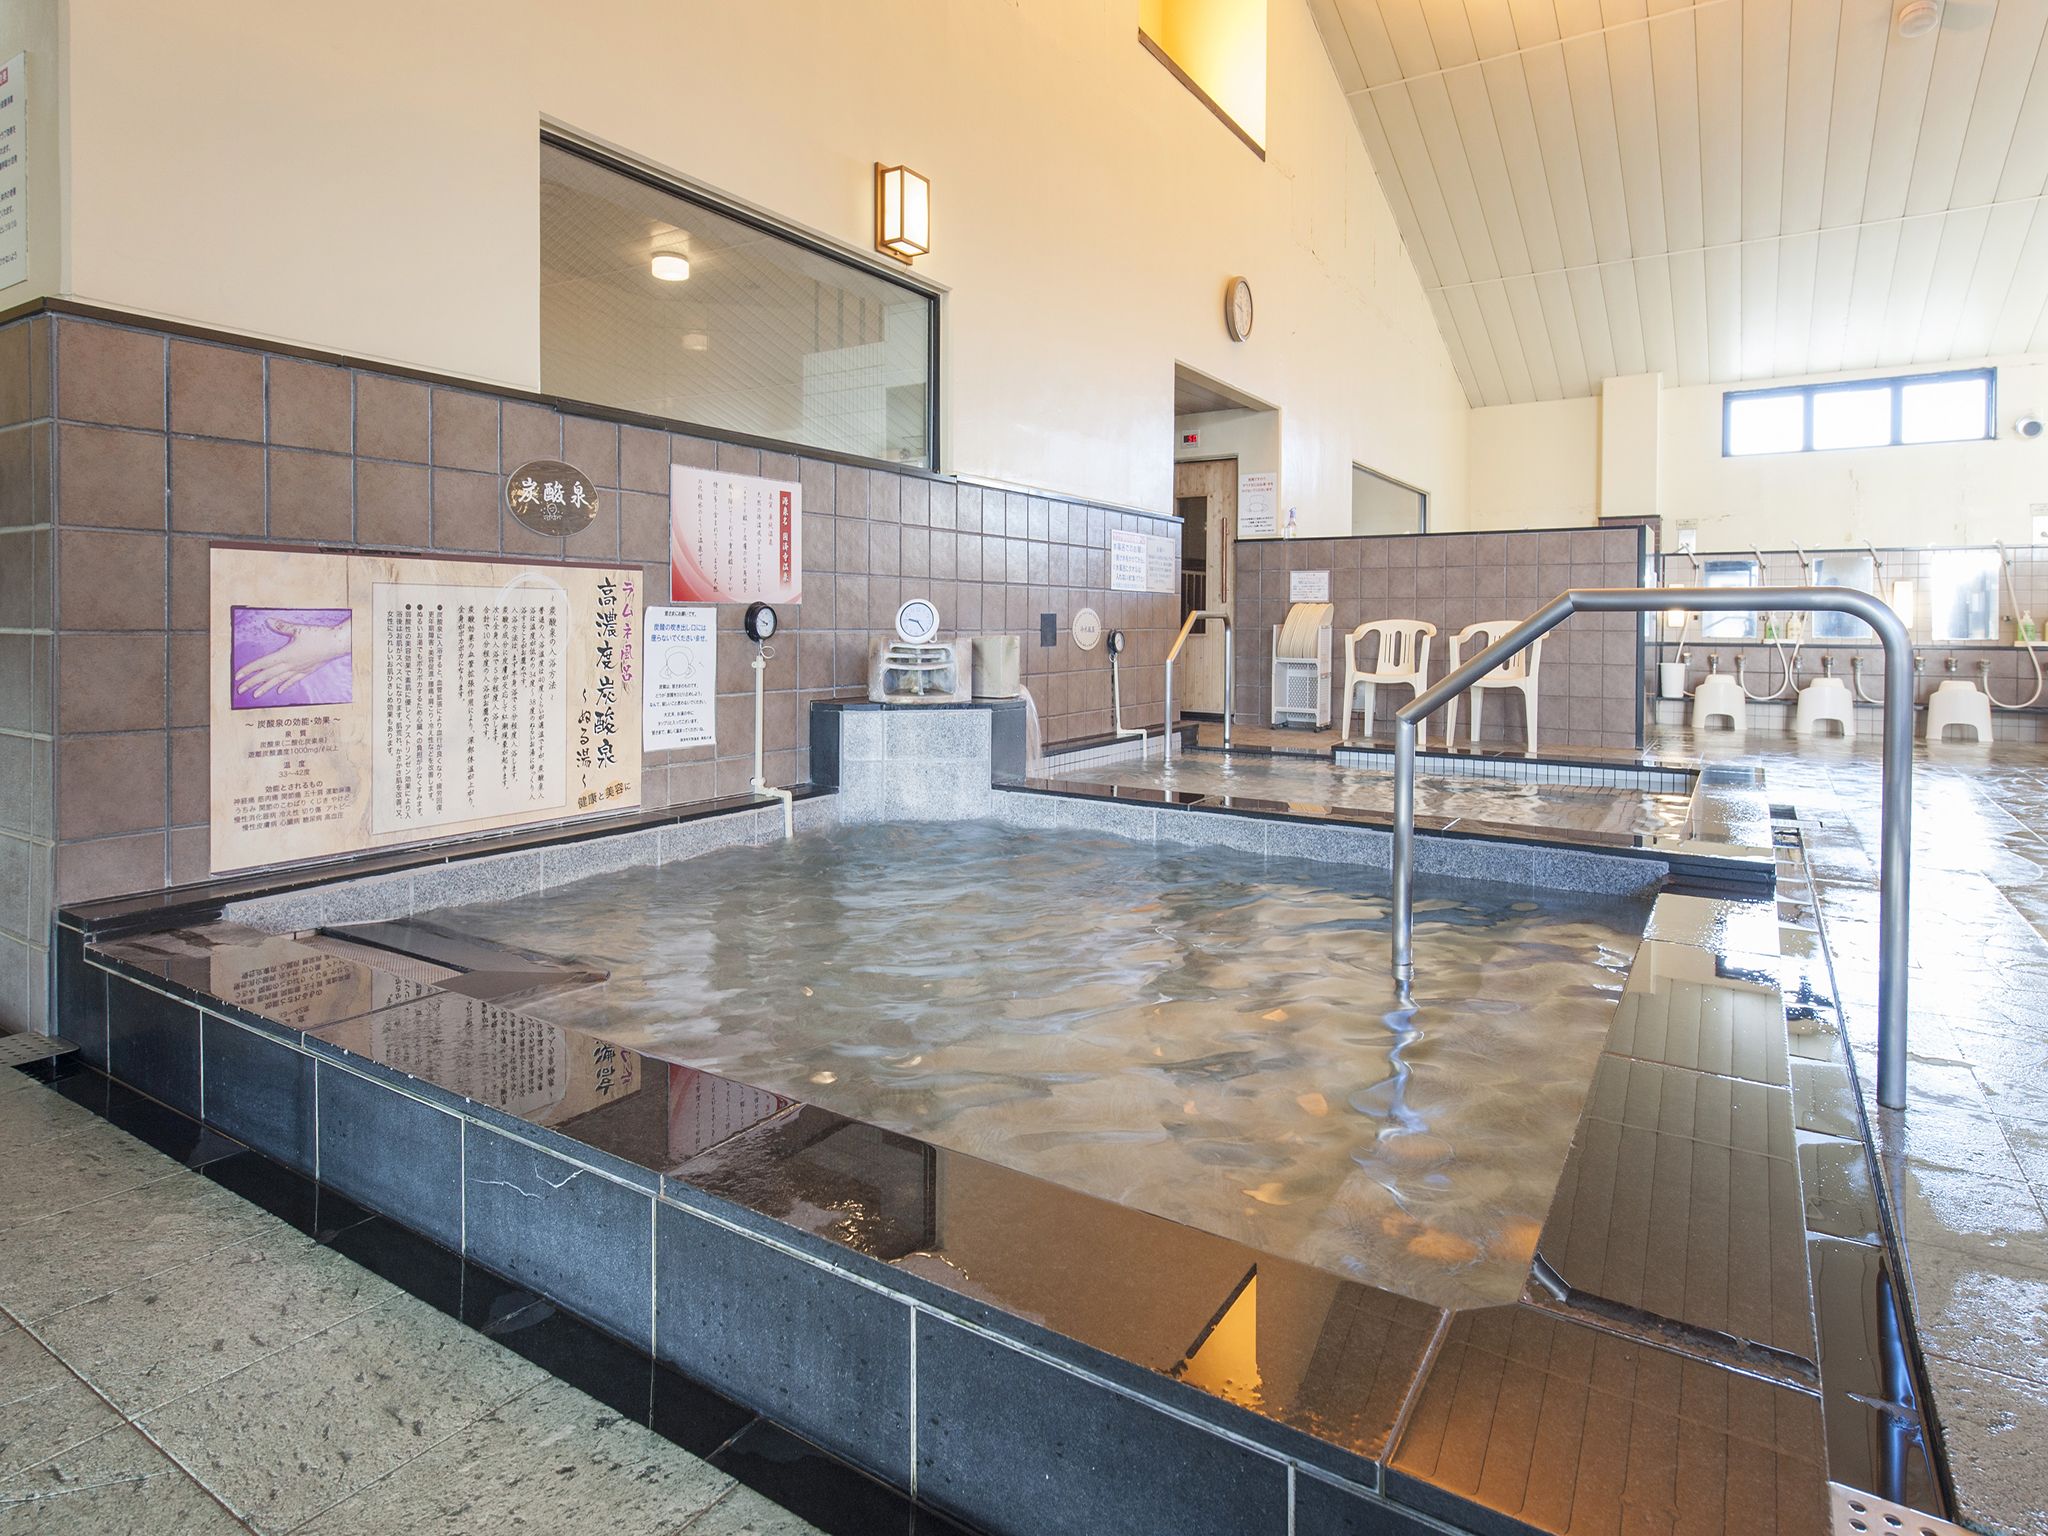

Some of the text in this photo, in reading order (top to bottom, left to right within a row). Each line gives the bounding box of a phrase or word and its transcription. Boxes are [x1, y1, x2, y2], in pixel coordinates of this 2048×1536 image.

[518, 477, 593, 508] 炭酸泉
[621, 581, 634, 682] ラムネ風呂
[594, 577, 620, 769] 高濃度炭酸泉
[266, 780, 323, 793] 効能とされるもの
[578, 782, 631, 810] 健康と美容に
[259, 800, 306, 810] 関節のこわばり
[310, 797, 328, 805] くじき
